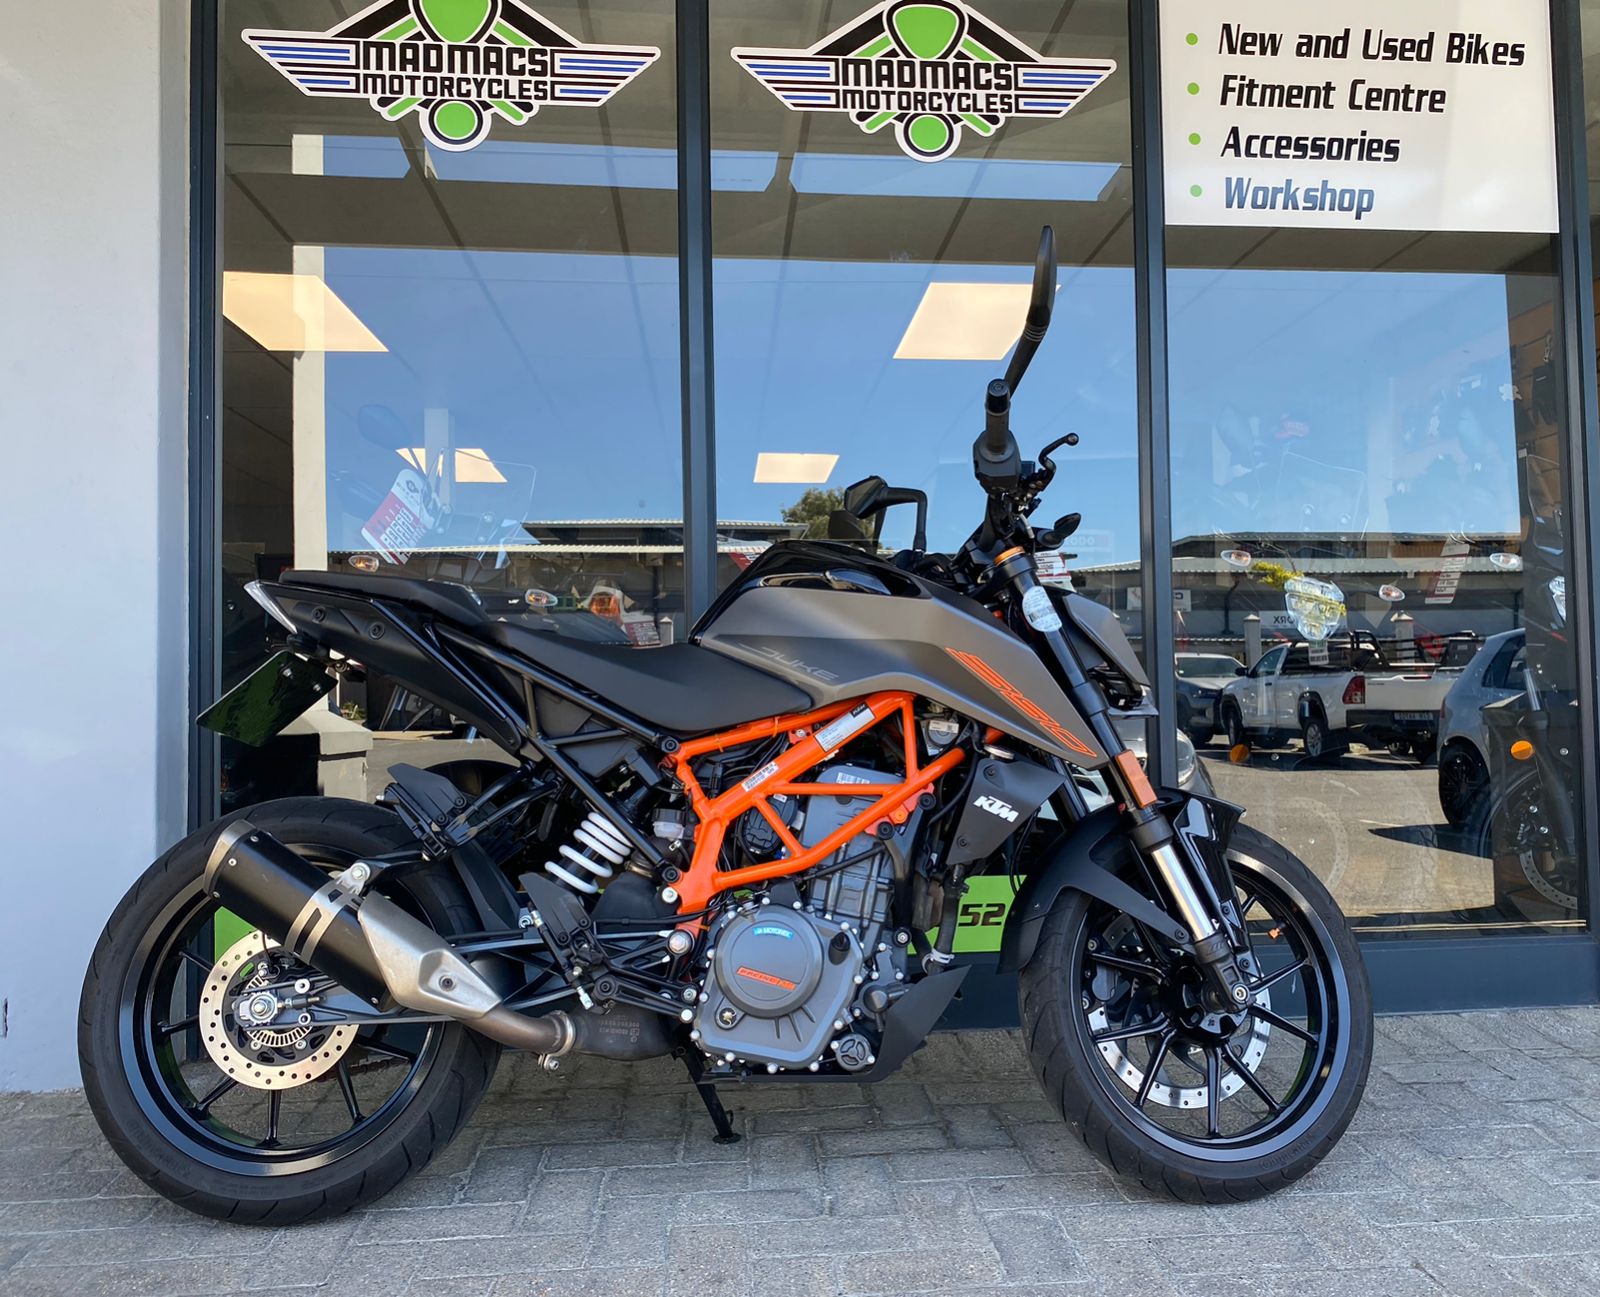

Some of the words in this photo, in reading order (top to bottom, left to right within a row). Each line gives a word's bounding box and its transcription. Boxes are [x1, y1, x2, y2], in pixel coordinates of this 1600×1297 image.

[362, 40, 549, 78] MADMACS
[1218, 23, 1283, 57] New
[1296, 28, 1351, 59] and
[1361, 29, 1436, 62] Used
[1445, 32, 1526, 67] Bikes
[362, 73, 549, 101] MOTORCYCLES
[841, 58, 1013, 91] MADMACS
[841, 88, 1013, 114] MOTORCYCLES
[1219, 74, 1336, 111] Fitment
[1348, 79, 1447, 113] Centre
[1220, 126, 1401, 163] Accessories
[1224, 177, 1375, 220] Workshop
[973, 795, 1019, 823] KTM
[958, 903, 1006, 927] 52
